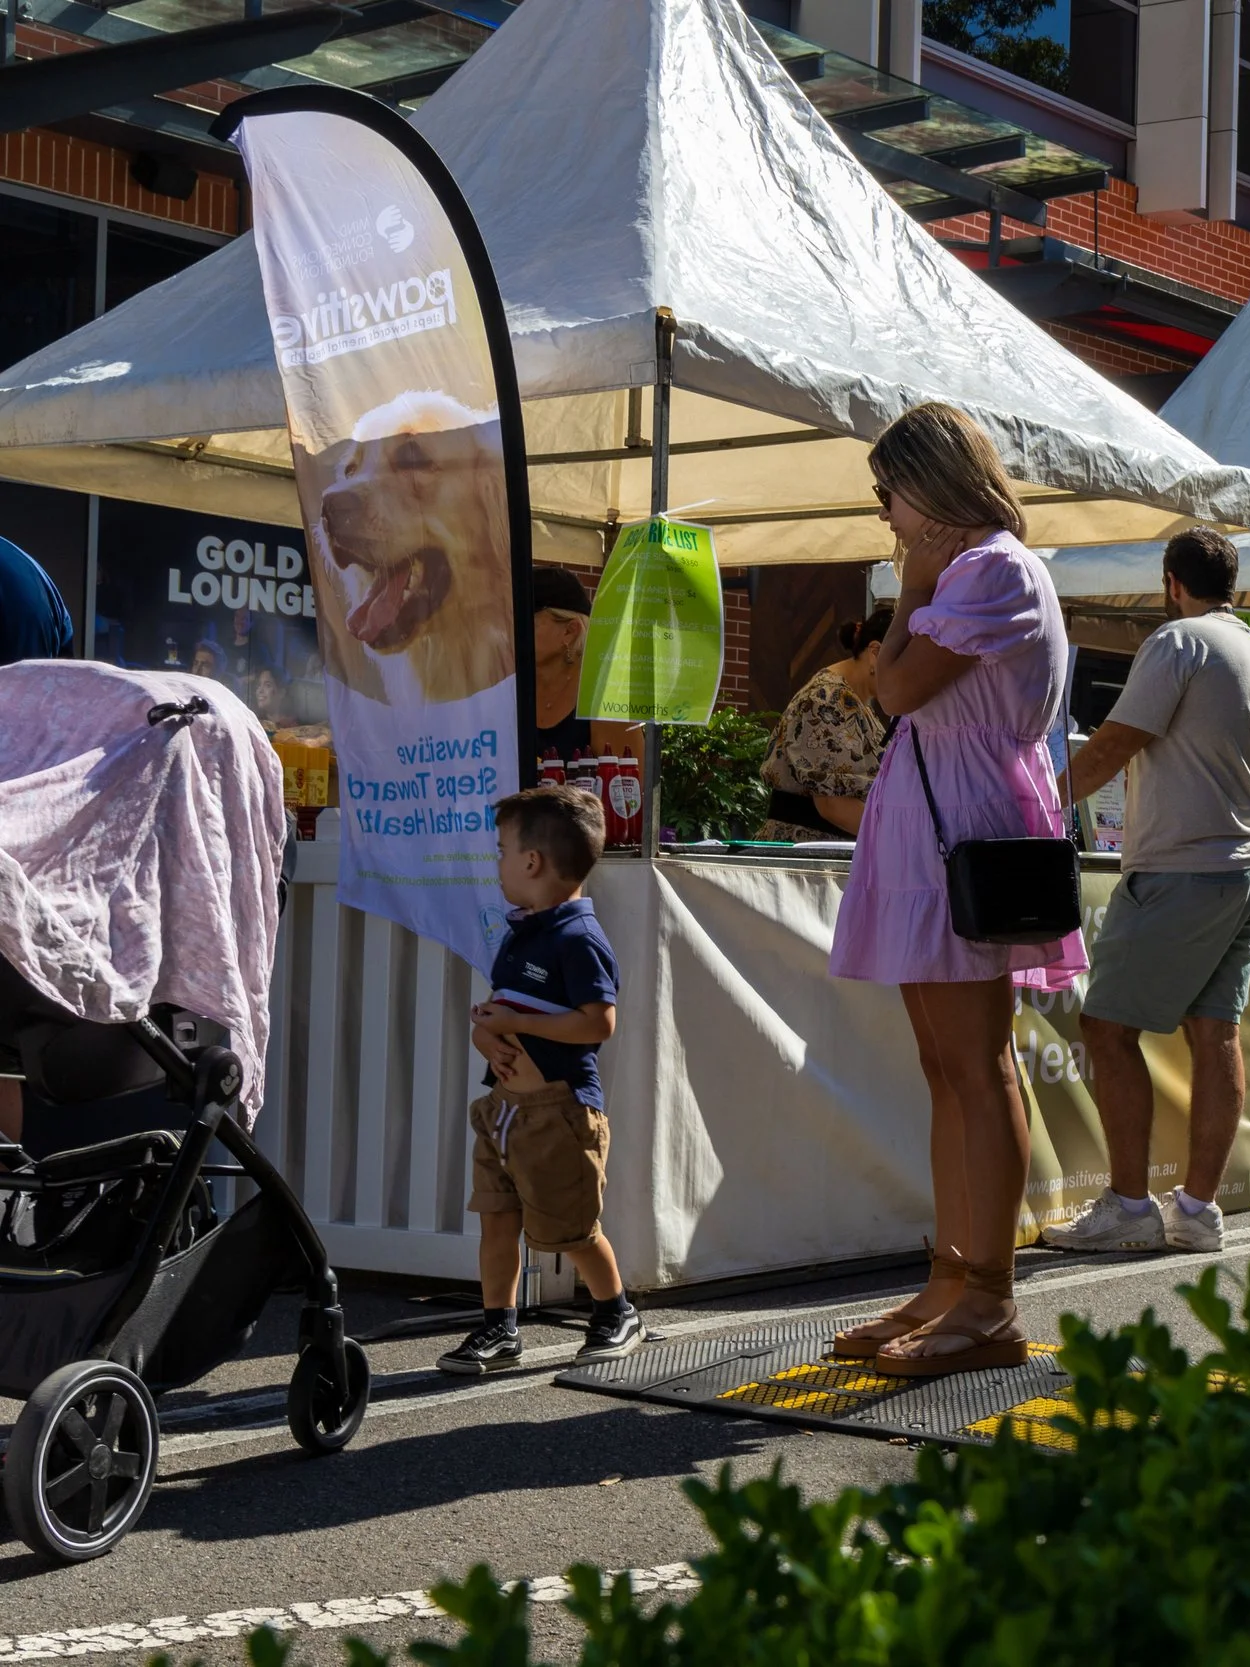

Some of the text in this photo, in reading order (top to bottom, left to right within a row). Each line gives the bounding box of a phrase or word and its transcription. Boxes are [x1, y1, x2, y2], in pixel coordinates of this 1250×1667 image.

[674, 528, 698, 551] LIST
[196, 535, 303, 579] GOLD
[168, 568, 316, 618] LOUNGE
[602, 702, 668, 716] Woolworths
